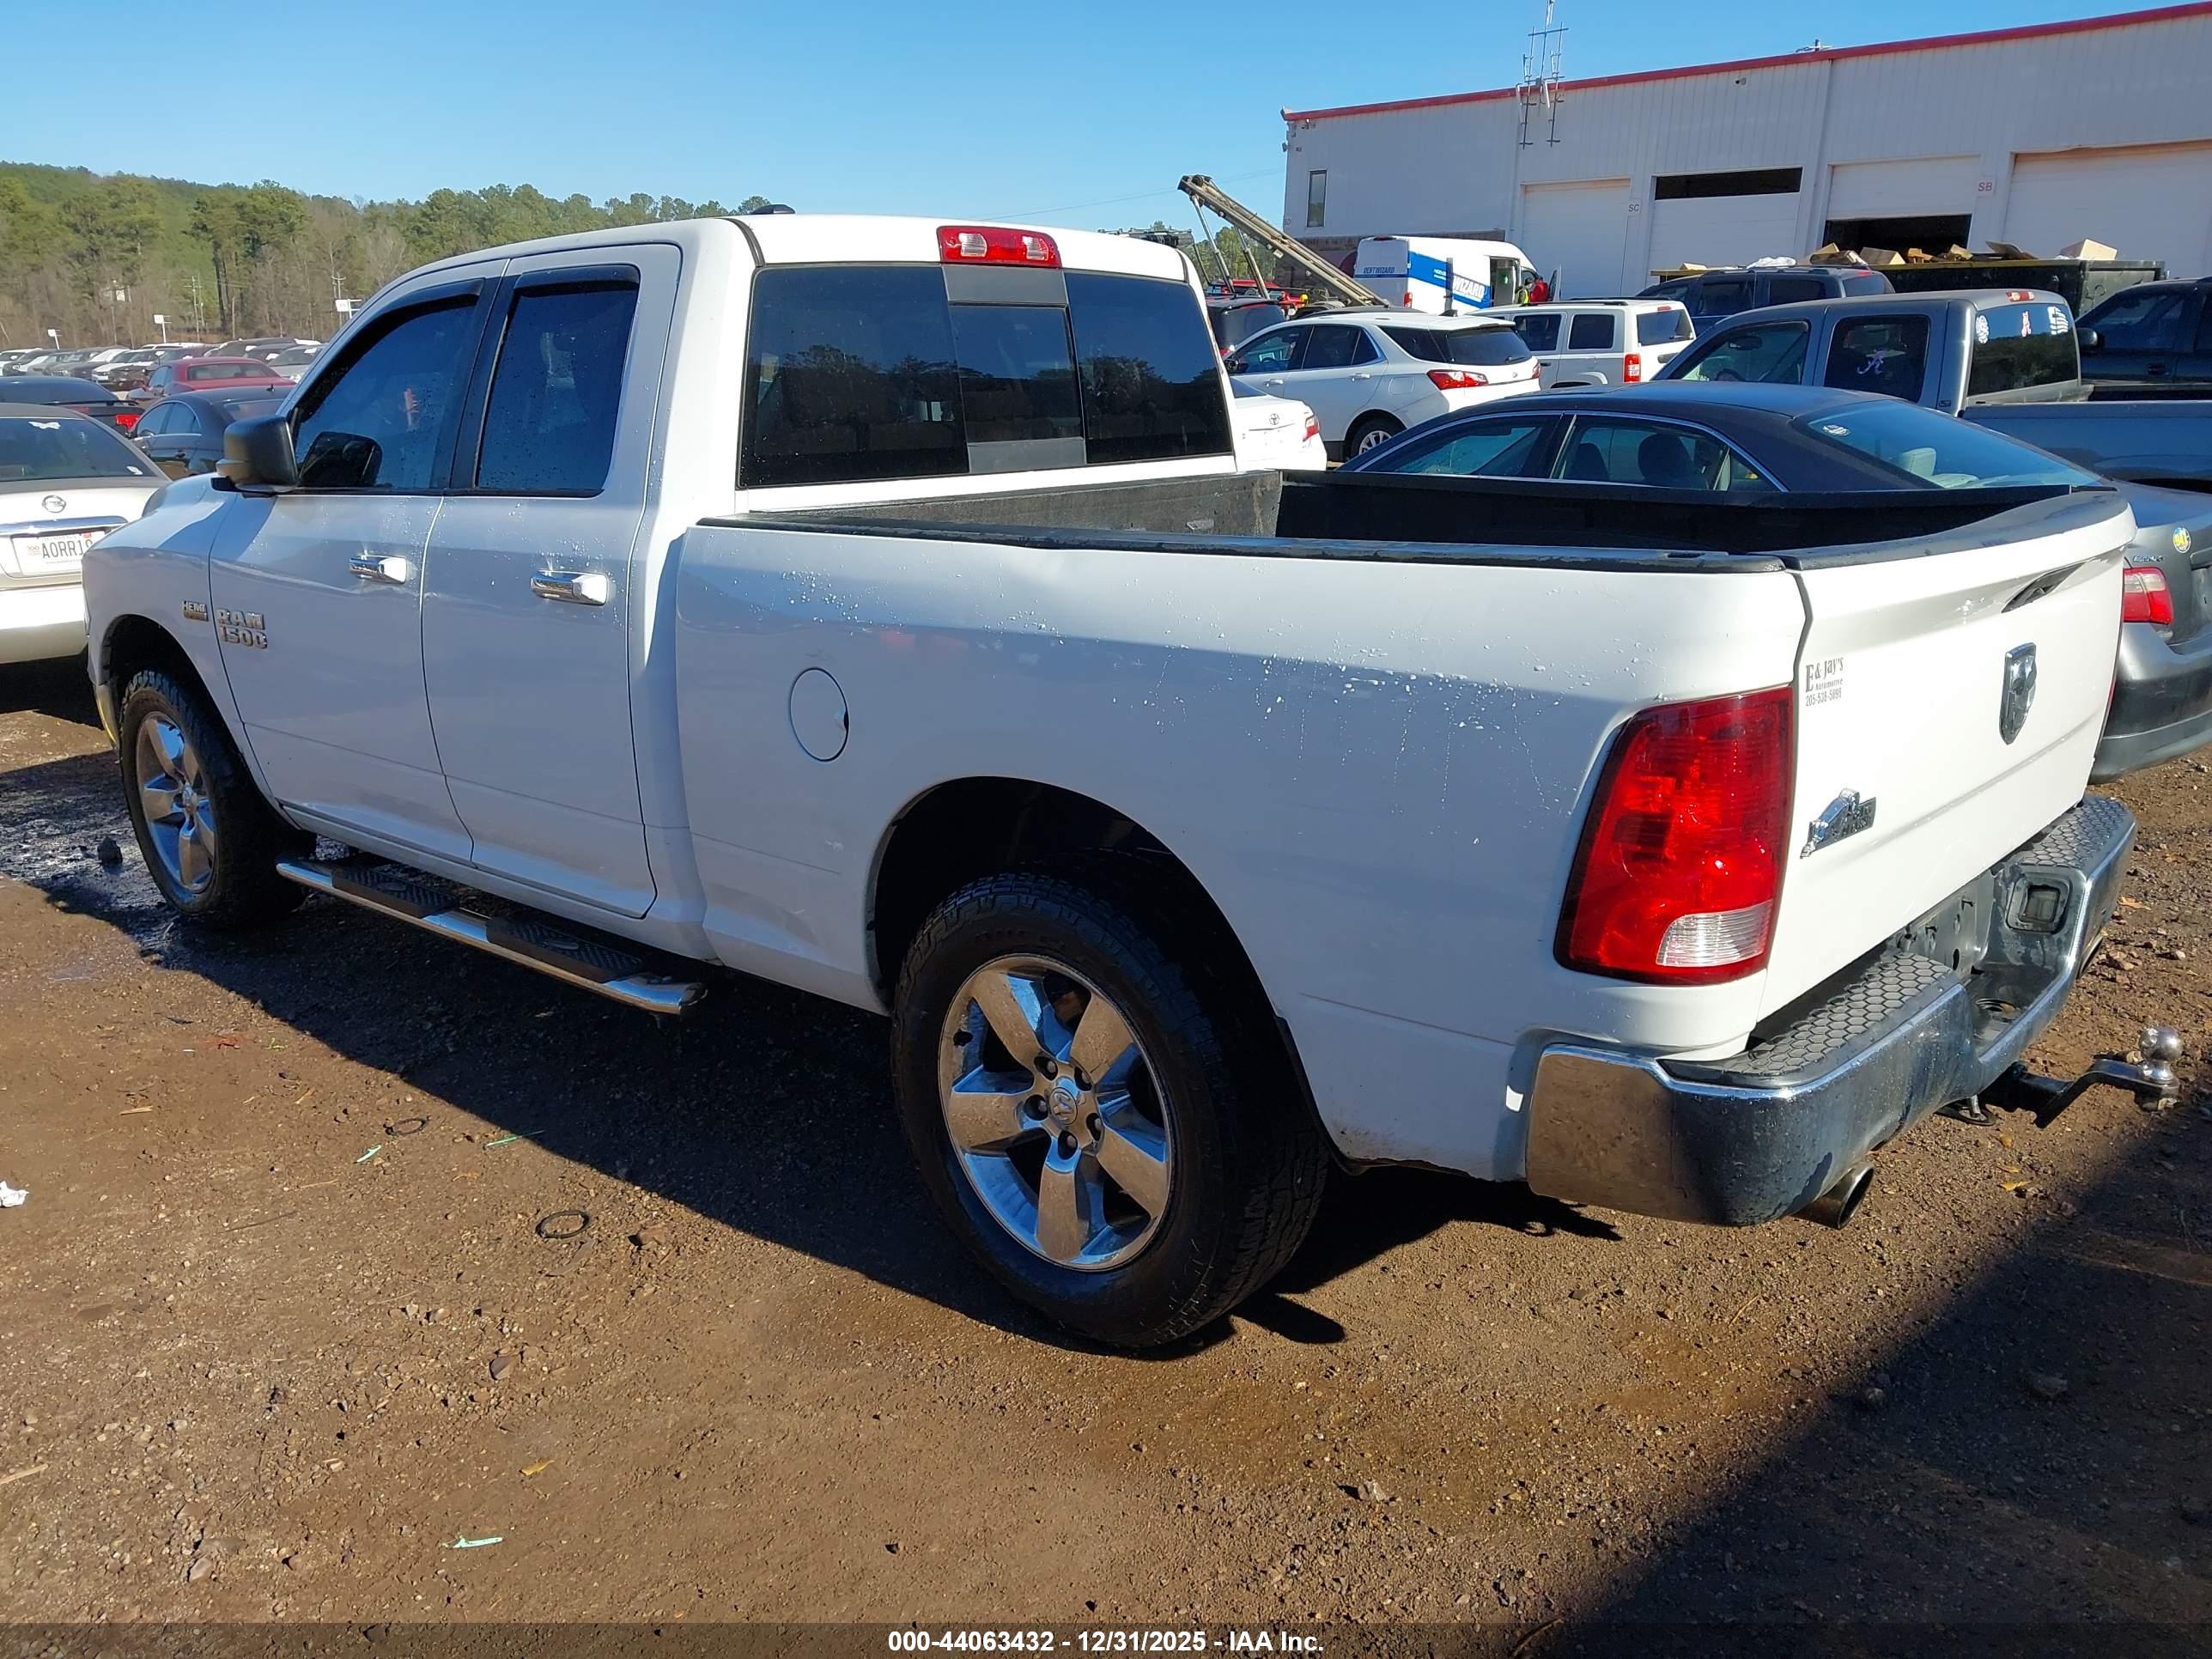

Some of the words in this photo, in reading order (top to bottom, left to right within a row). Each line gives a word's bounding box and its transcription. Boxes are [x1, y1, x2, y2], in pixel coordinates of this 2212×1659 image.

[1978, 181, 1992, 191] SB
[1453, 275, 1485, 299] WIZARD
[182, 600, 207, 613] HEMI
[216, 608, 265, 629] RAM
[220, 625, 268, 649] 1500
[1806, 665, 1814, 693] E
[1814, 662, 1821, 679] &
[1824, 657, 1844, 680] Jay's
